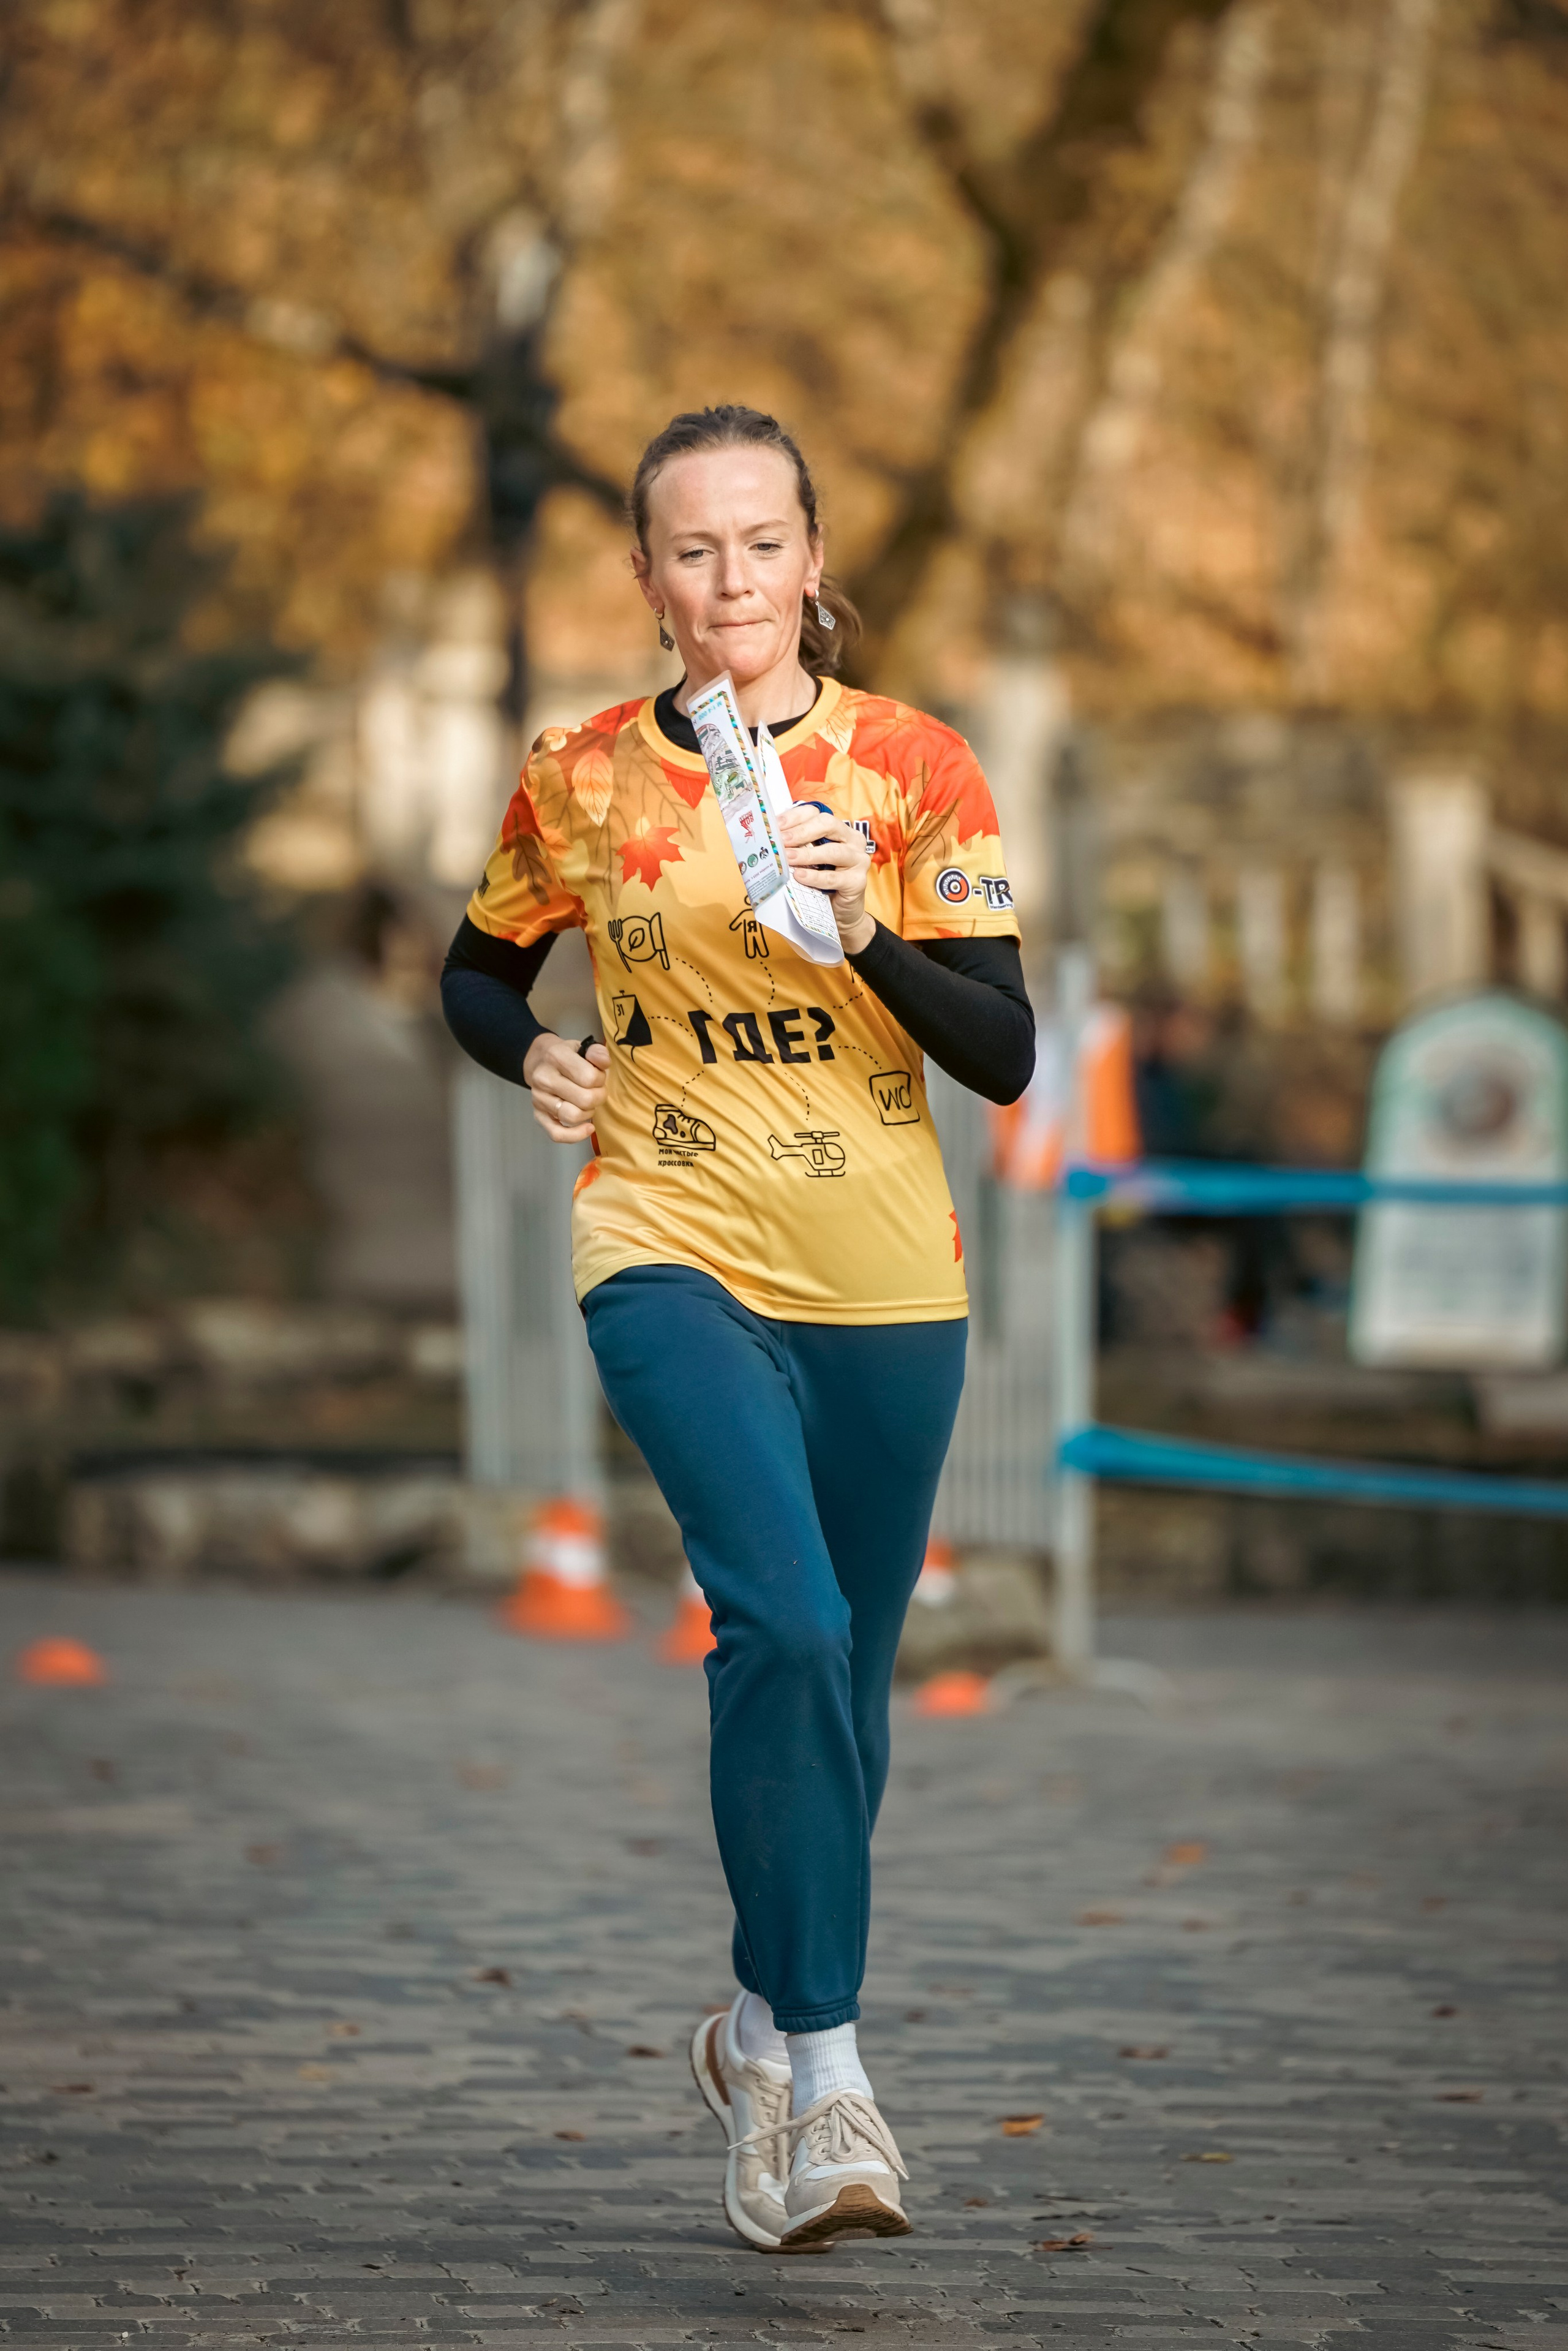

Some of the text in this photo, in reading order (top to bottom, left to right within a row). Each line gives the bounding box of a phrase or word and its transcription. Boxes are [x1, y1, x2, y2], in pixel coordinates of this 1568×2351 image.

[747, 920, 758, 933] Я
[616, 1003, 625, 1016] 31
[687, 1006, 837, 1065] ГДЕ?
